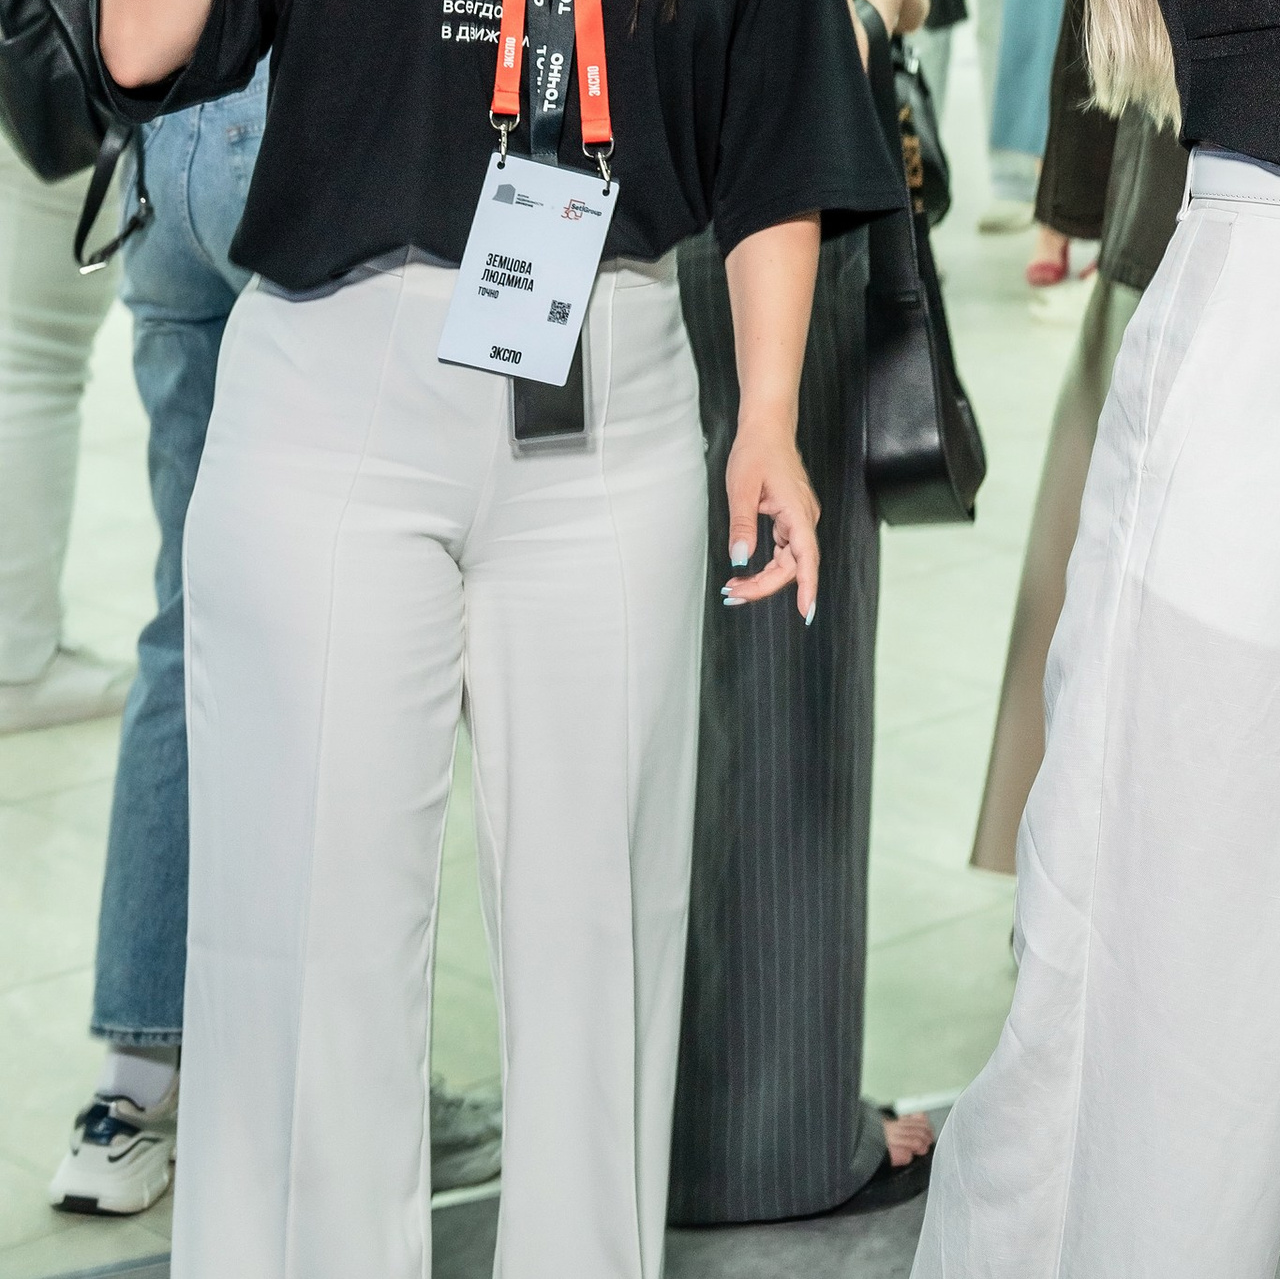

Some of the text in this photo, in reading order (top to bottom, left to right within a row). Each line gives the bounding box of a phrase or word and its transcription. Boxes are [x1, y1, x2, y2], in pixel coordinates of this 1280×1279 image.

[441, 25, 452, 39] в
[503, 36, 517, 69] ЭКСПО
[543, 53, 564, 113] ТОЧНО
[586, 65, 601, 97] ЭКСПО
[485, 252, 533, 276] ЗЕМЦОВА
[477, 286, 500, 299] ТОЧНО
[480, 268, 535, 293] ЛЮДМИЛА
[489, 345, 522, 365] ЭКСПО
